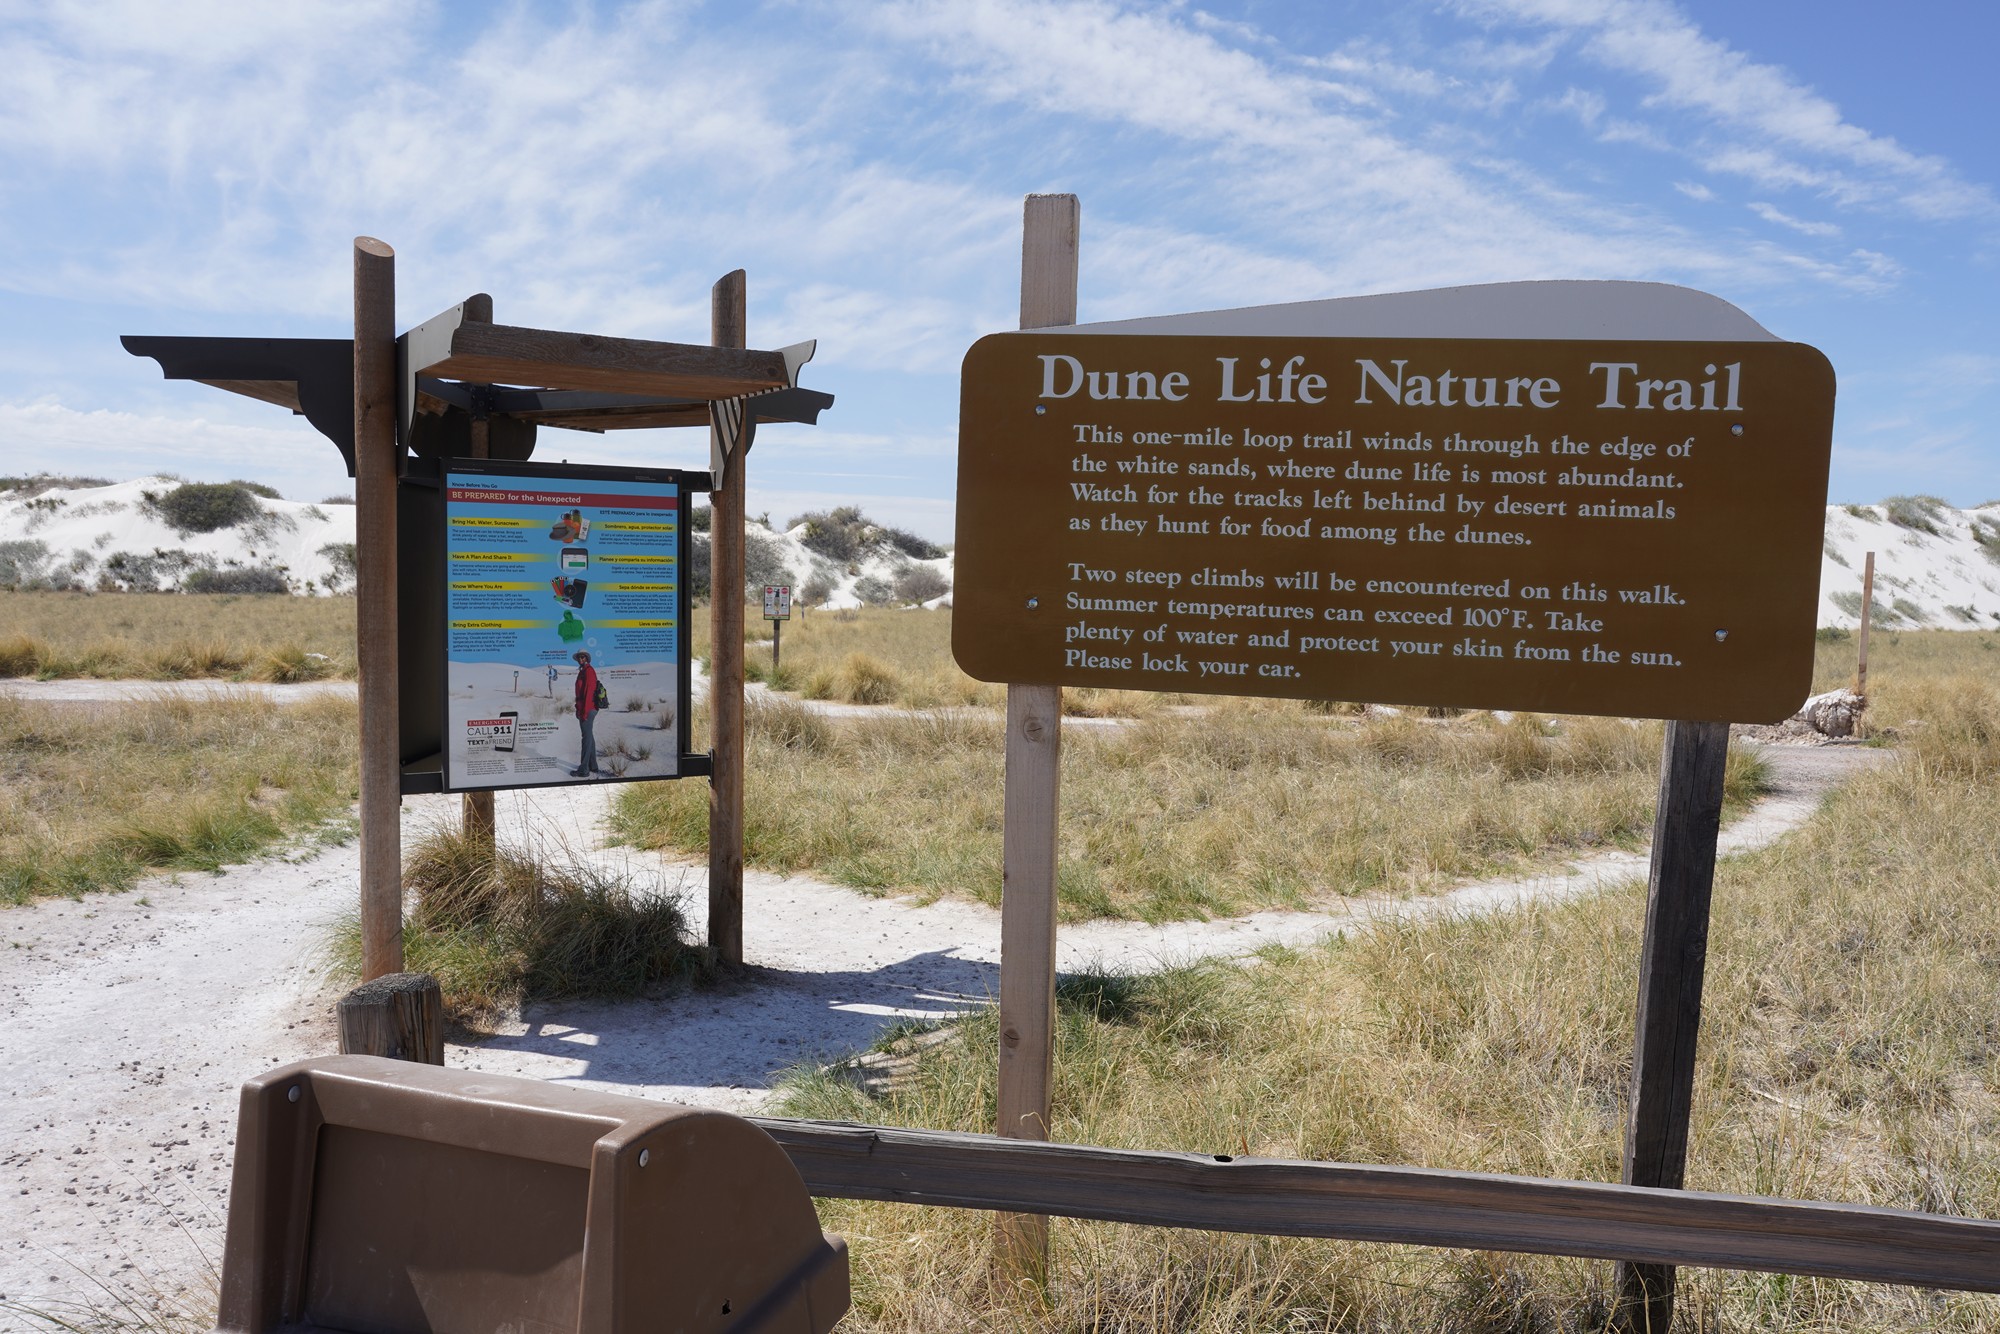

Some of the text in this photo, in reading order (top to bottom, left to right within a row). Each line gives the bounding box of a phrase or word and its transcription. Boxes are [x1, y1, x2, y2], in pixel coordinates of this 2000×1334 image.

[1036, 354, 1744, 411] Dune Life Nature Trail
[1073, 424, 1695, 461] This one-mile loop trail winds through the edge of
[1071, 453, 1684, 489] the white sands, where dune life is most abundant.
[465, 492, 505, 500] PREPARED
[508, 493, 519, 501] for
[536, 495, 580, 504] Unexpected
[1070, 482, 1676, 520] Watch for the tracks left behind by desert animals
[1069, 512, 1532, 546] as they hunt for food among the dunes.
[1067, 562, 1686, 605] Two steep climbs will be encountered on this walk.
[1066, 591, 1604, 633] Summer temperatures can exceed 100°F. Take
[1065, 620, 1682, 667] plenty of water and protect your skin from the sun.
[1065, 648, 1301, 678] Please lock your car.
[467, 726, 512, 736] CALL 911
